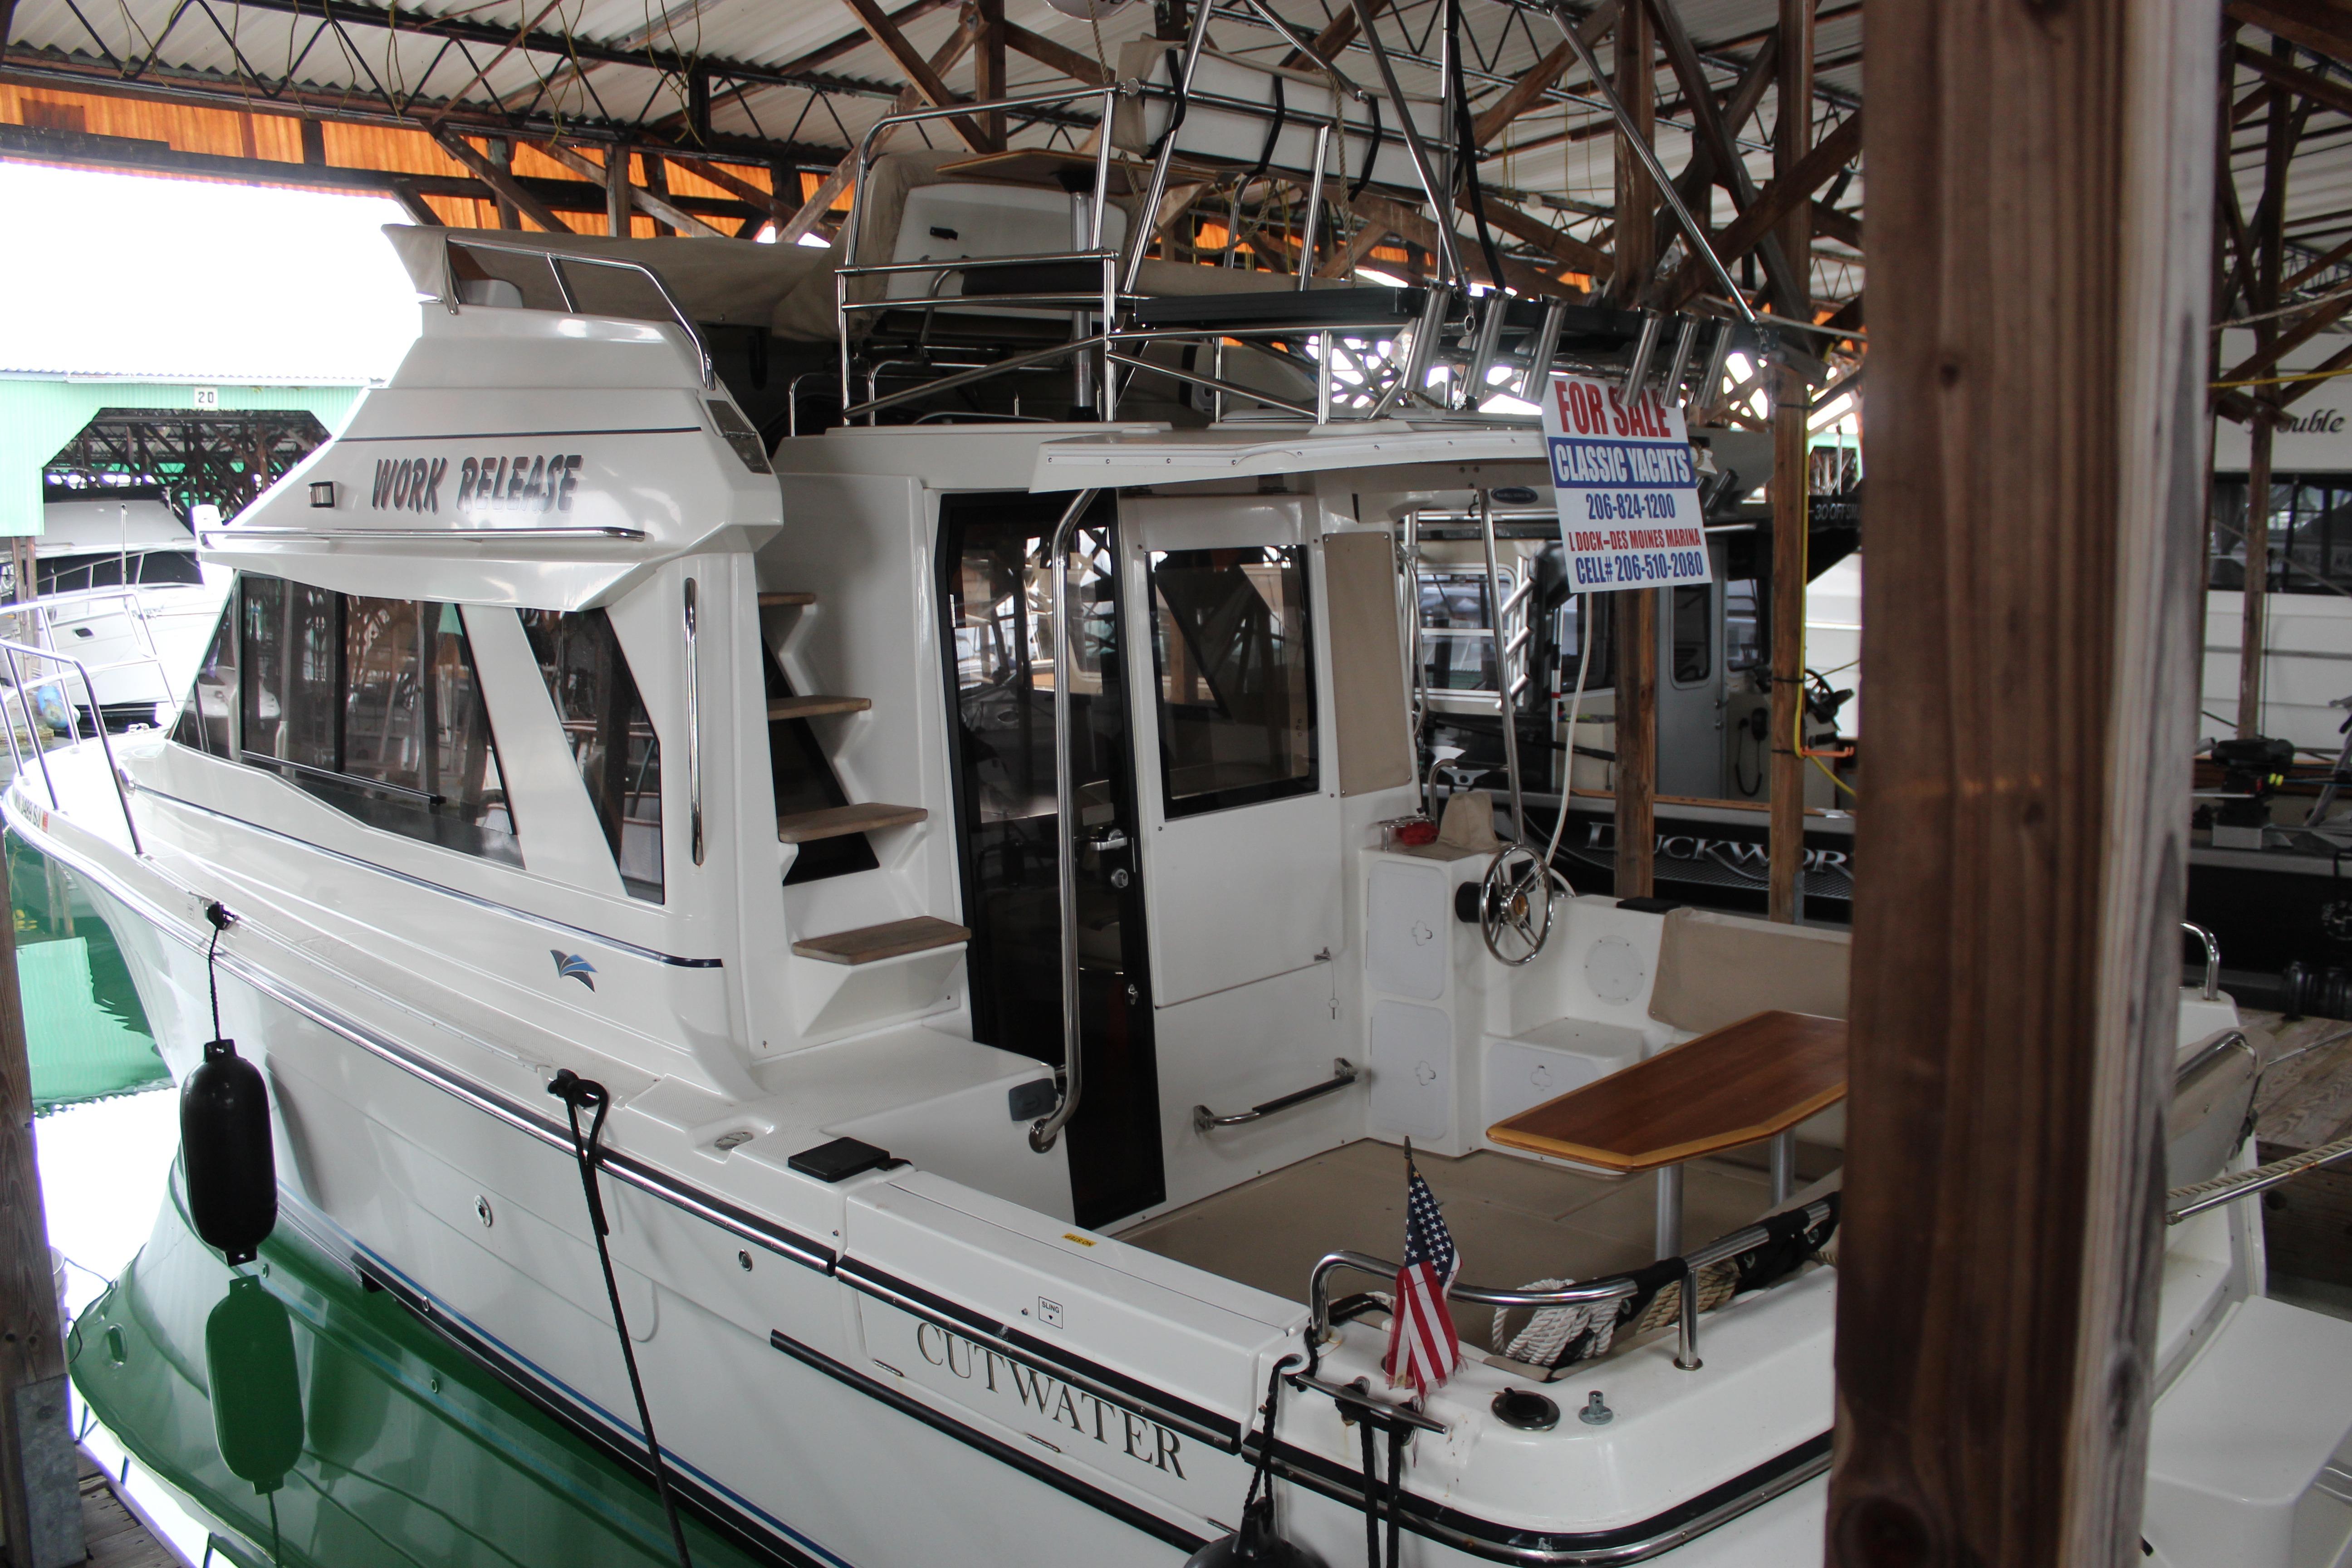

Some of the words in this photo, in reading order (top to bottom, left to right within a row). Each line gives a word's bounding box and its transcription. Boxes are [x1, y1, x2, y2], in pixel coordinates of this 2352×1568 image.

[198, 392, 214, 403] 20
[1554, 381, 1609, 435] FOR
[1608, 386, 1671, 437] SALE
[1554, 444, 1628, 483] CLASSIC
[1626, 448, 1690, 483] YACHTS
[372, 458, 448, 515] WORK
[456, 454, 584, 515] RELEASE
[1586, 493, 1676, 520] 206-824-1200
[1568, 532, 1575, 551] L
[1629, 529, 1665, 549] MOINES
[1665, 528, 1701, 547] MARINA
[1576, 556, 1613, 584] CELL#
[1615, 551, 1704, 581] 206-510-2080
[1042, 1301, 1059, 1313] SLING
[917, 1322, 1187, 1480] CUTWATER
